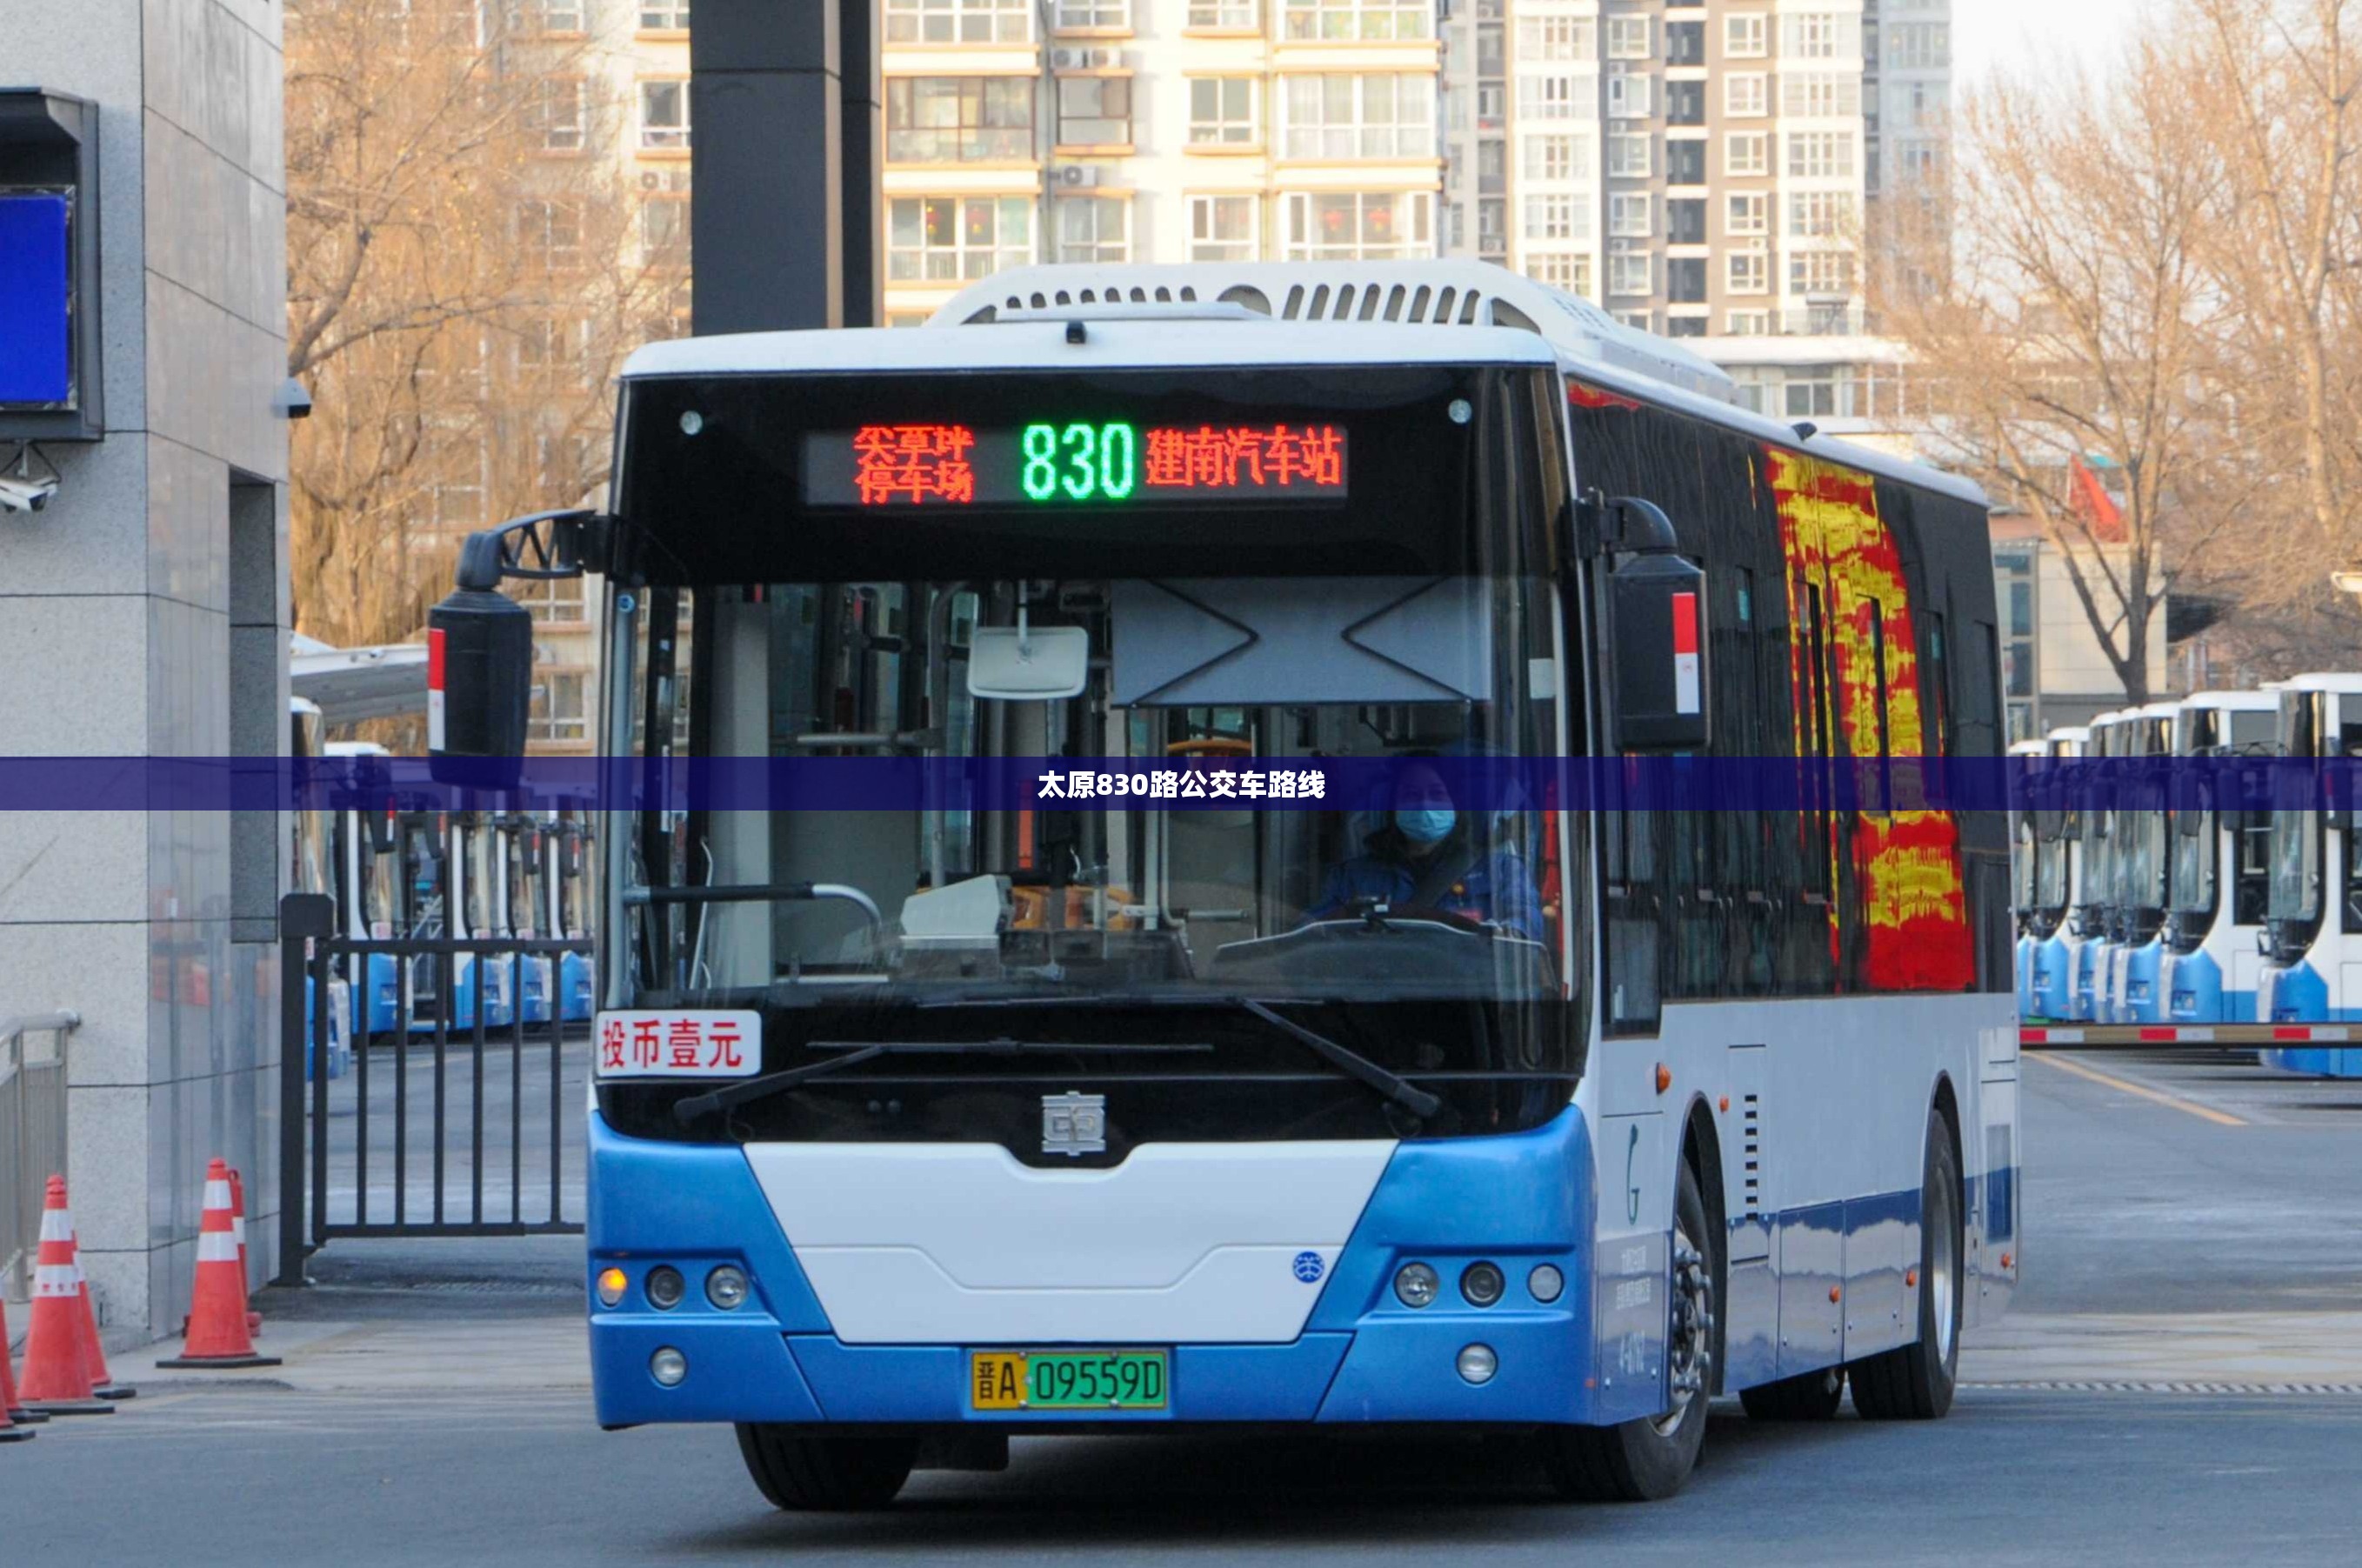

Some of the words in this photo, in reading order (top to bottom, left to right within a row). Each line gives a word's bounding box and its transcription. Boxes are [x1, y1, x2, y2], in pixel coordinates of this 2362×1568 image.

[1023, 424, 1133, 500] 830
[1145, 424, 1342, 487] 建南汽车站
[853, 461, 975, 504] 停车场
[603, 1018, 743, 1069] 投币壹元
[1035, 1359, 1162, 1401] 09559D
